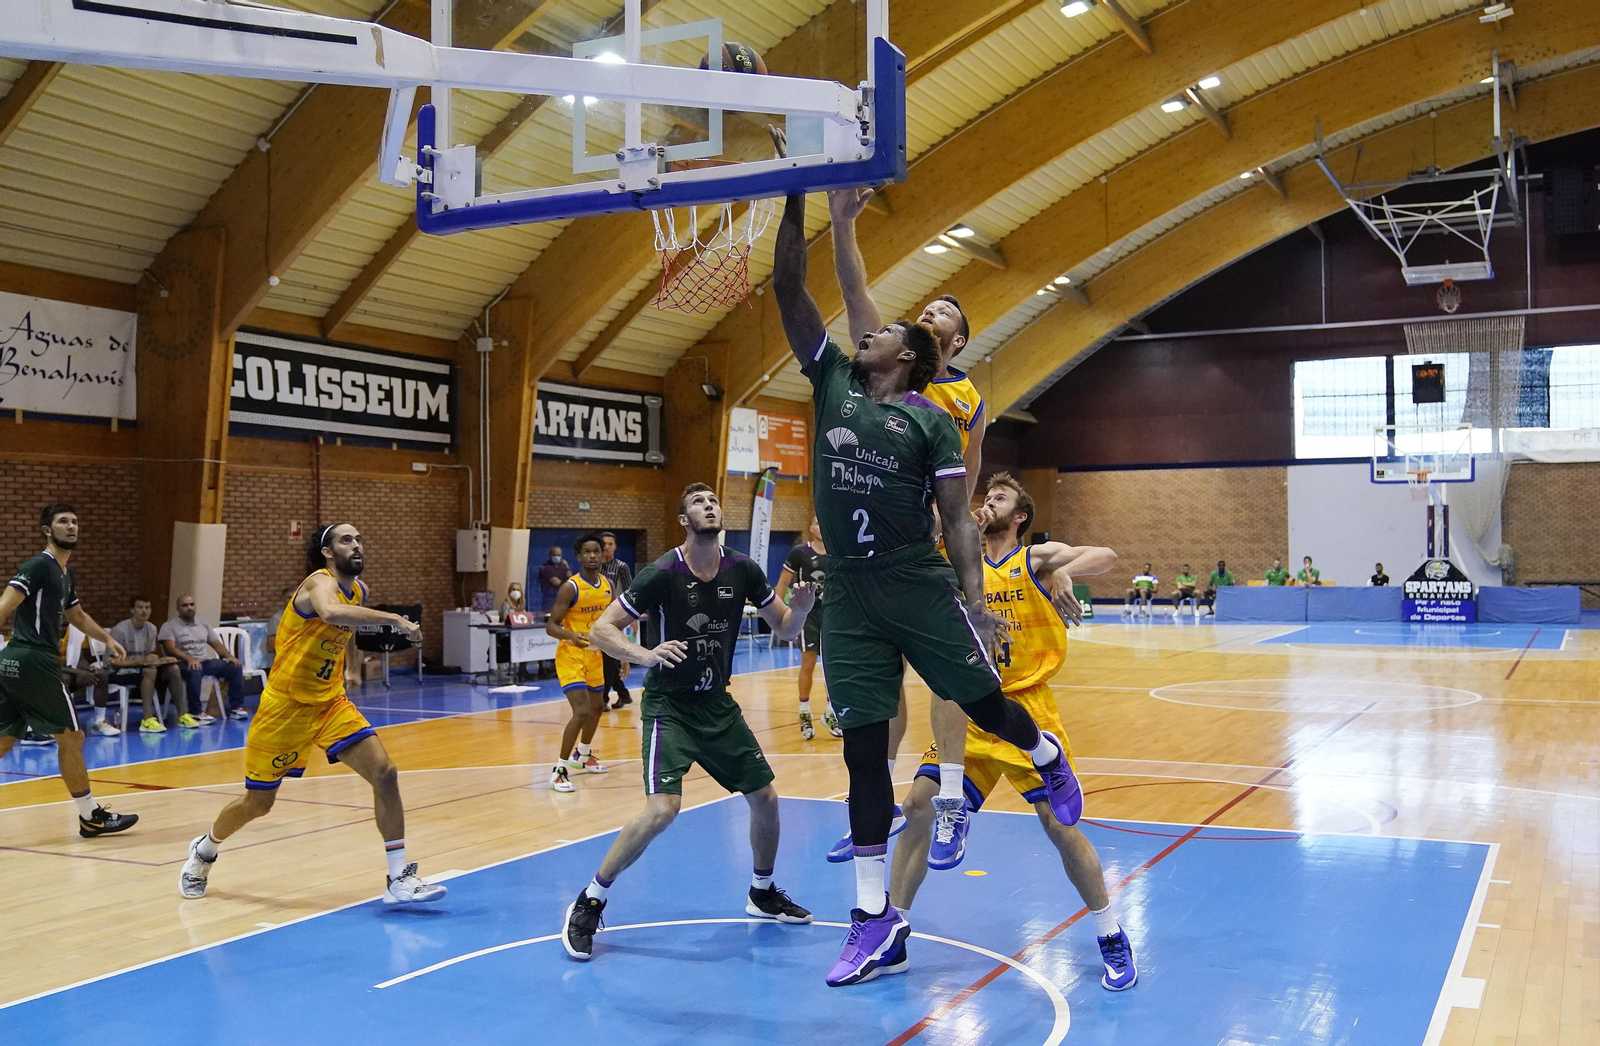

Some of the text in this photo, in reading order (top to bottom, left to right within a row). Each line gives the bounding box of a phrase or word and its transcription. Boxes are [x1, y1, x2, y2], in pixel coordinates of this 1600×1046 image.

[0, 311, 129, 357] Aguas de
[1573, 431, 1592, 443] DE
[855, 447, 899, 471] Unicaja
[831, 461, 884, 495] Málaga
[852, 508, 875, 544] 2
[1405, 581, 1472, 593] SPARTANS
[1410, 613, 1466, 622] de Deportes
[1417, 606, 1459, 615] Municipal
